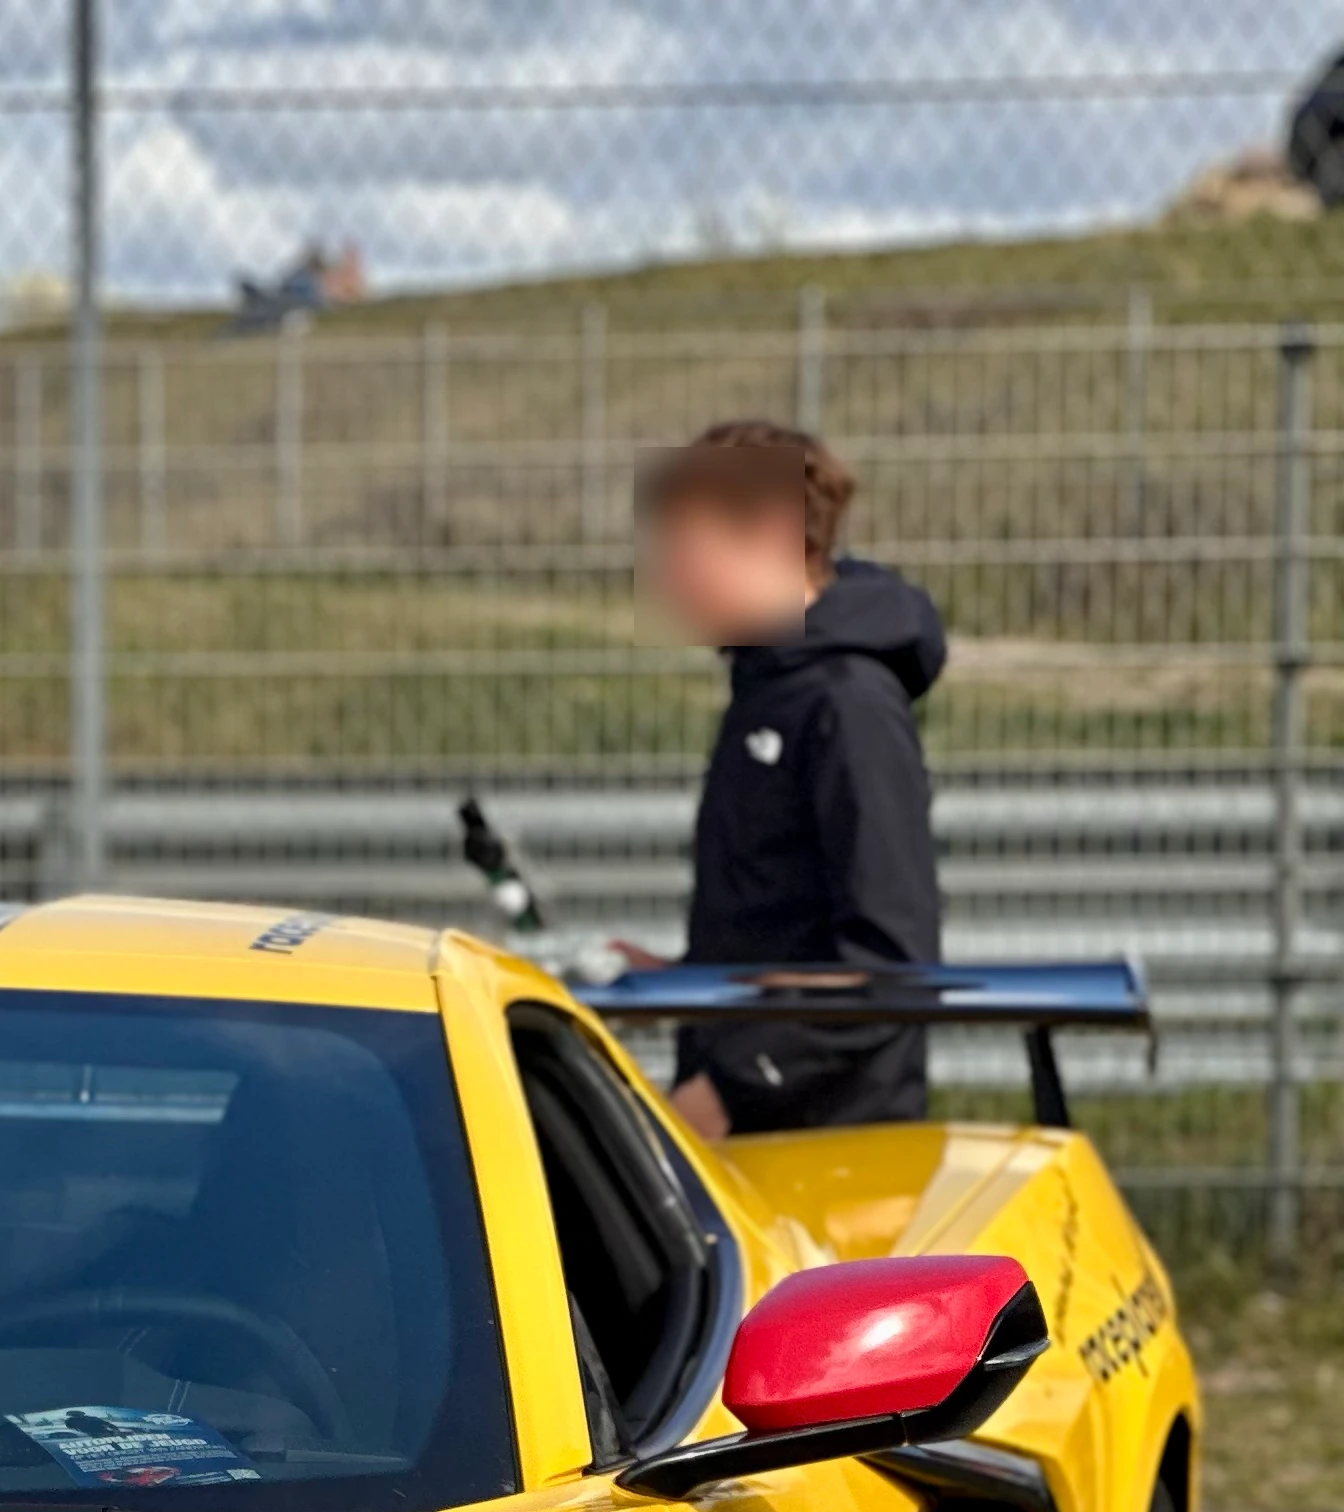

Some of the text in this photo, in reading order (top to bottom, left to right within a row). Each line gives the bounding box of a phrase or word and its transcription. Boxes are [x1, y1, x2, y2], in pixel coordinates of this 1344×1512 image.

[62, 1444, 115, 1456] VOOR
[118, 1440, 144, 1450] DE
[148, 1438, 207, 1448] JEUGD
